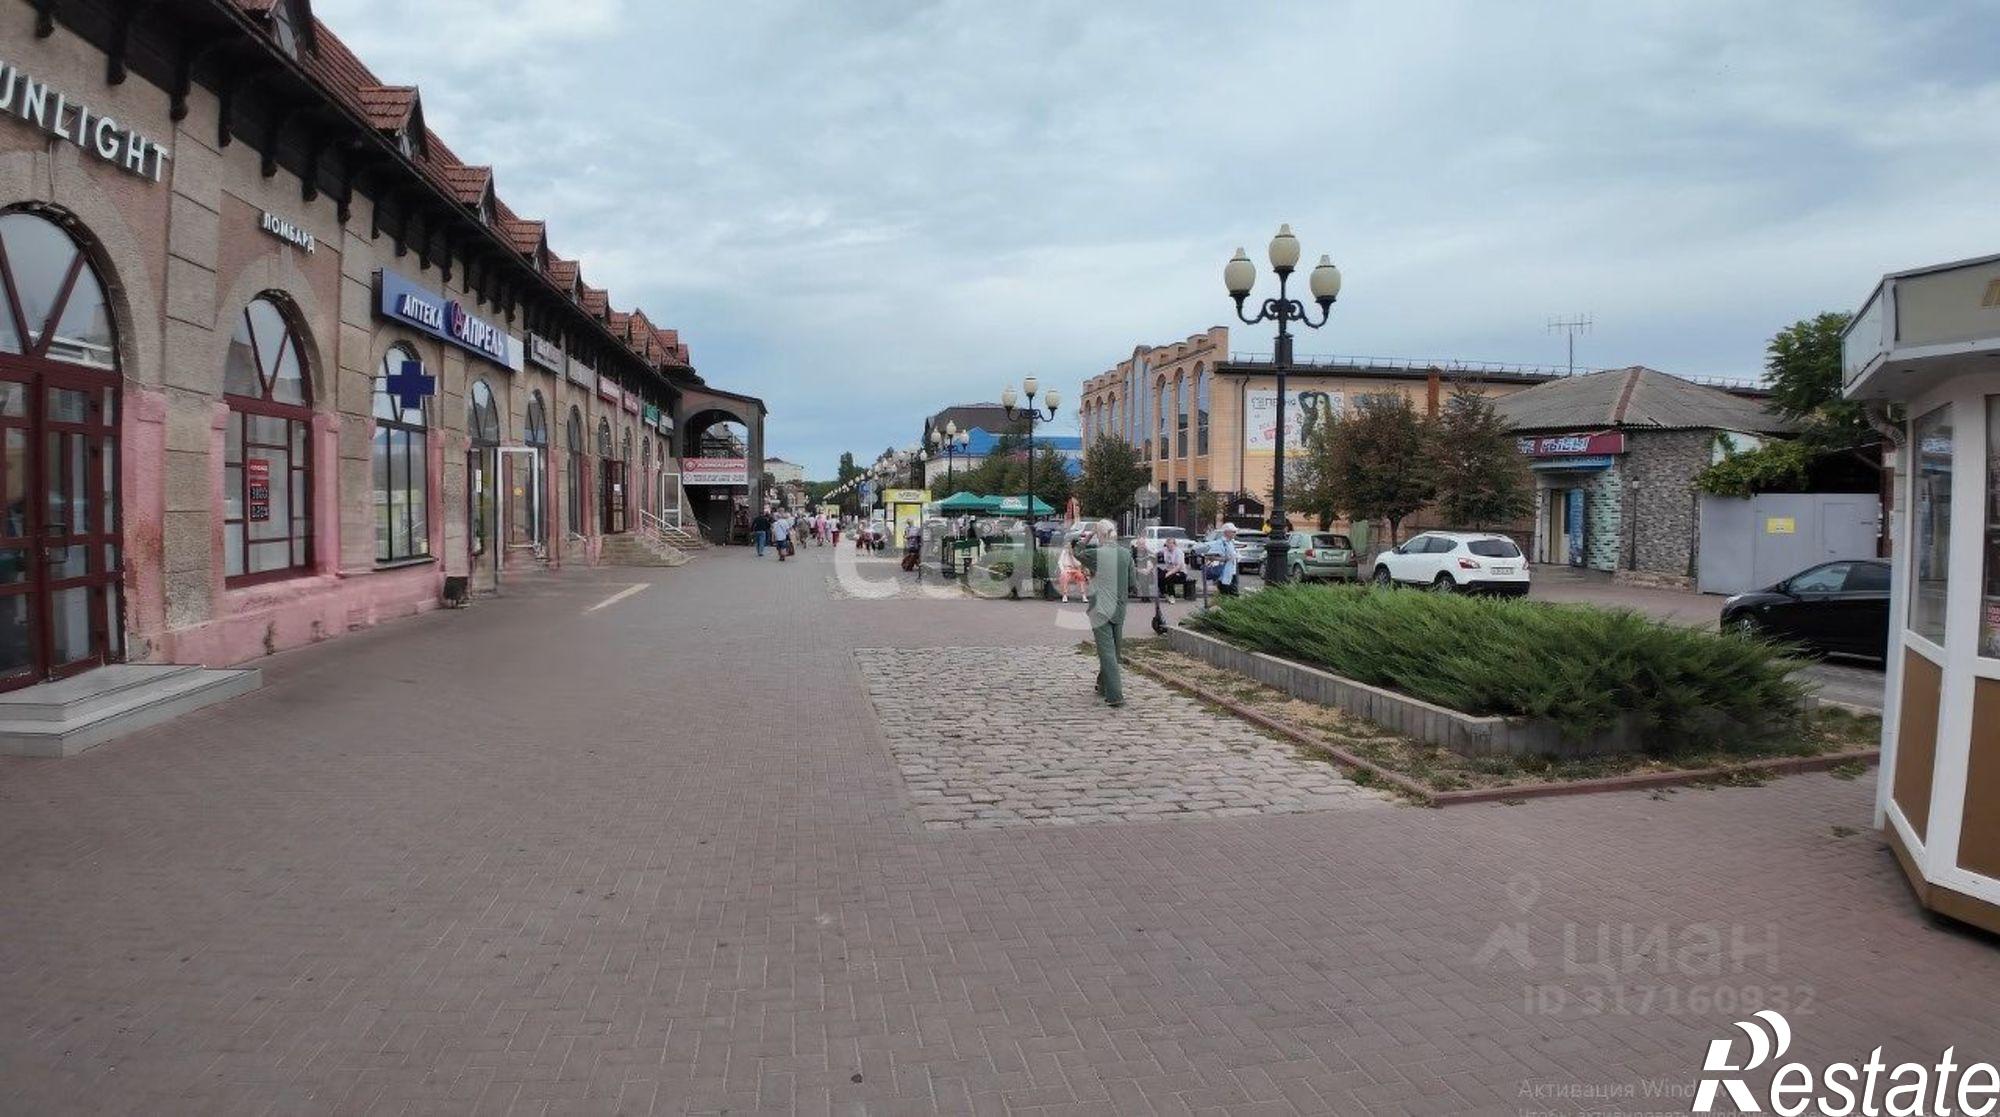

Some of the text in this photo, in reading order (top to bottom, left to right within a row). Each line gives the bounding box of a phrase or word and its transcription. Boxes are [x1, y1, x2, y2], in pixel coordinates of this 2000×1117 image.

[263, 211, 315, 254] ЛОМБАРД
[402, 294, 444, 330] АПТЕКА
[461, 314, 504, 356] АПРЕЛЬ
